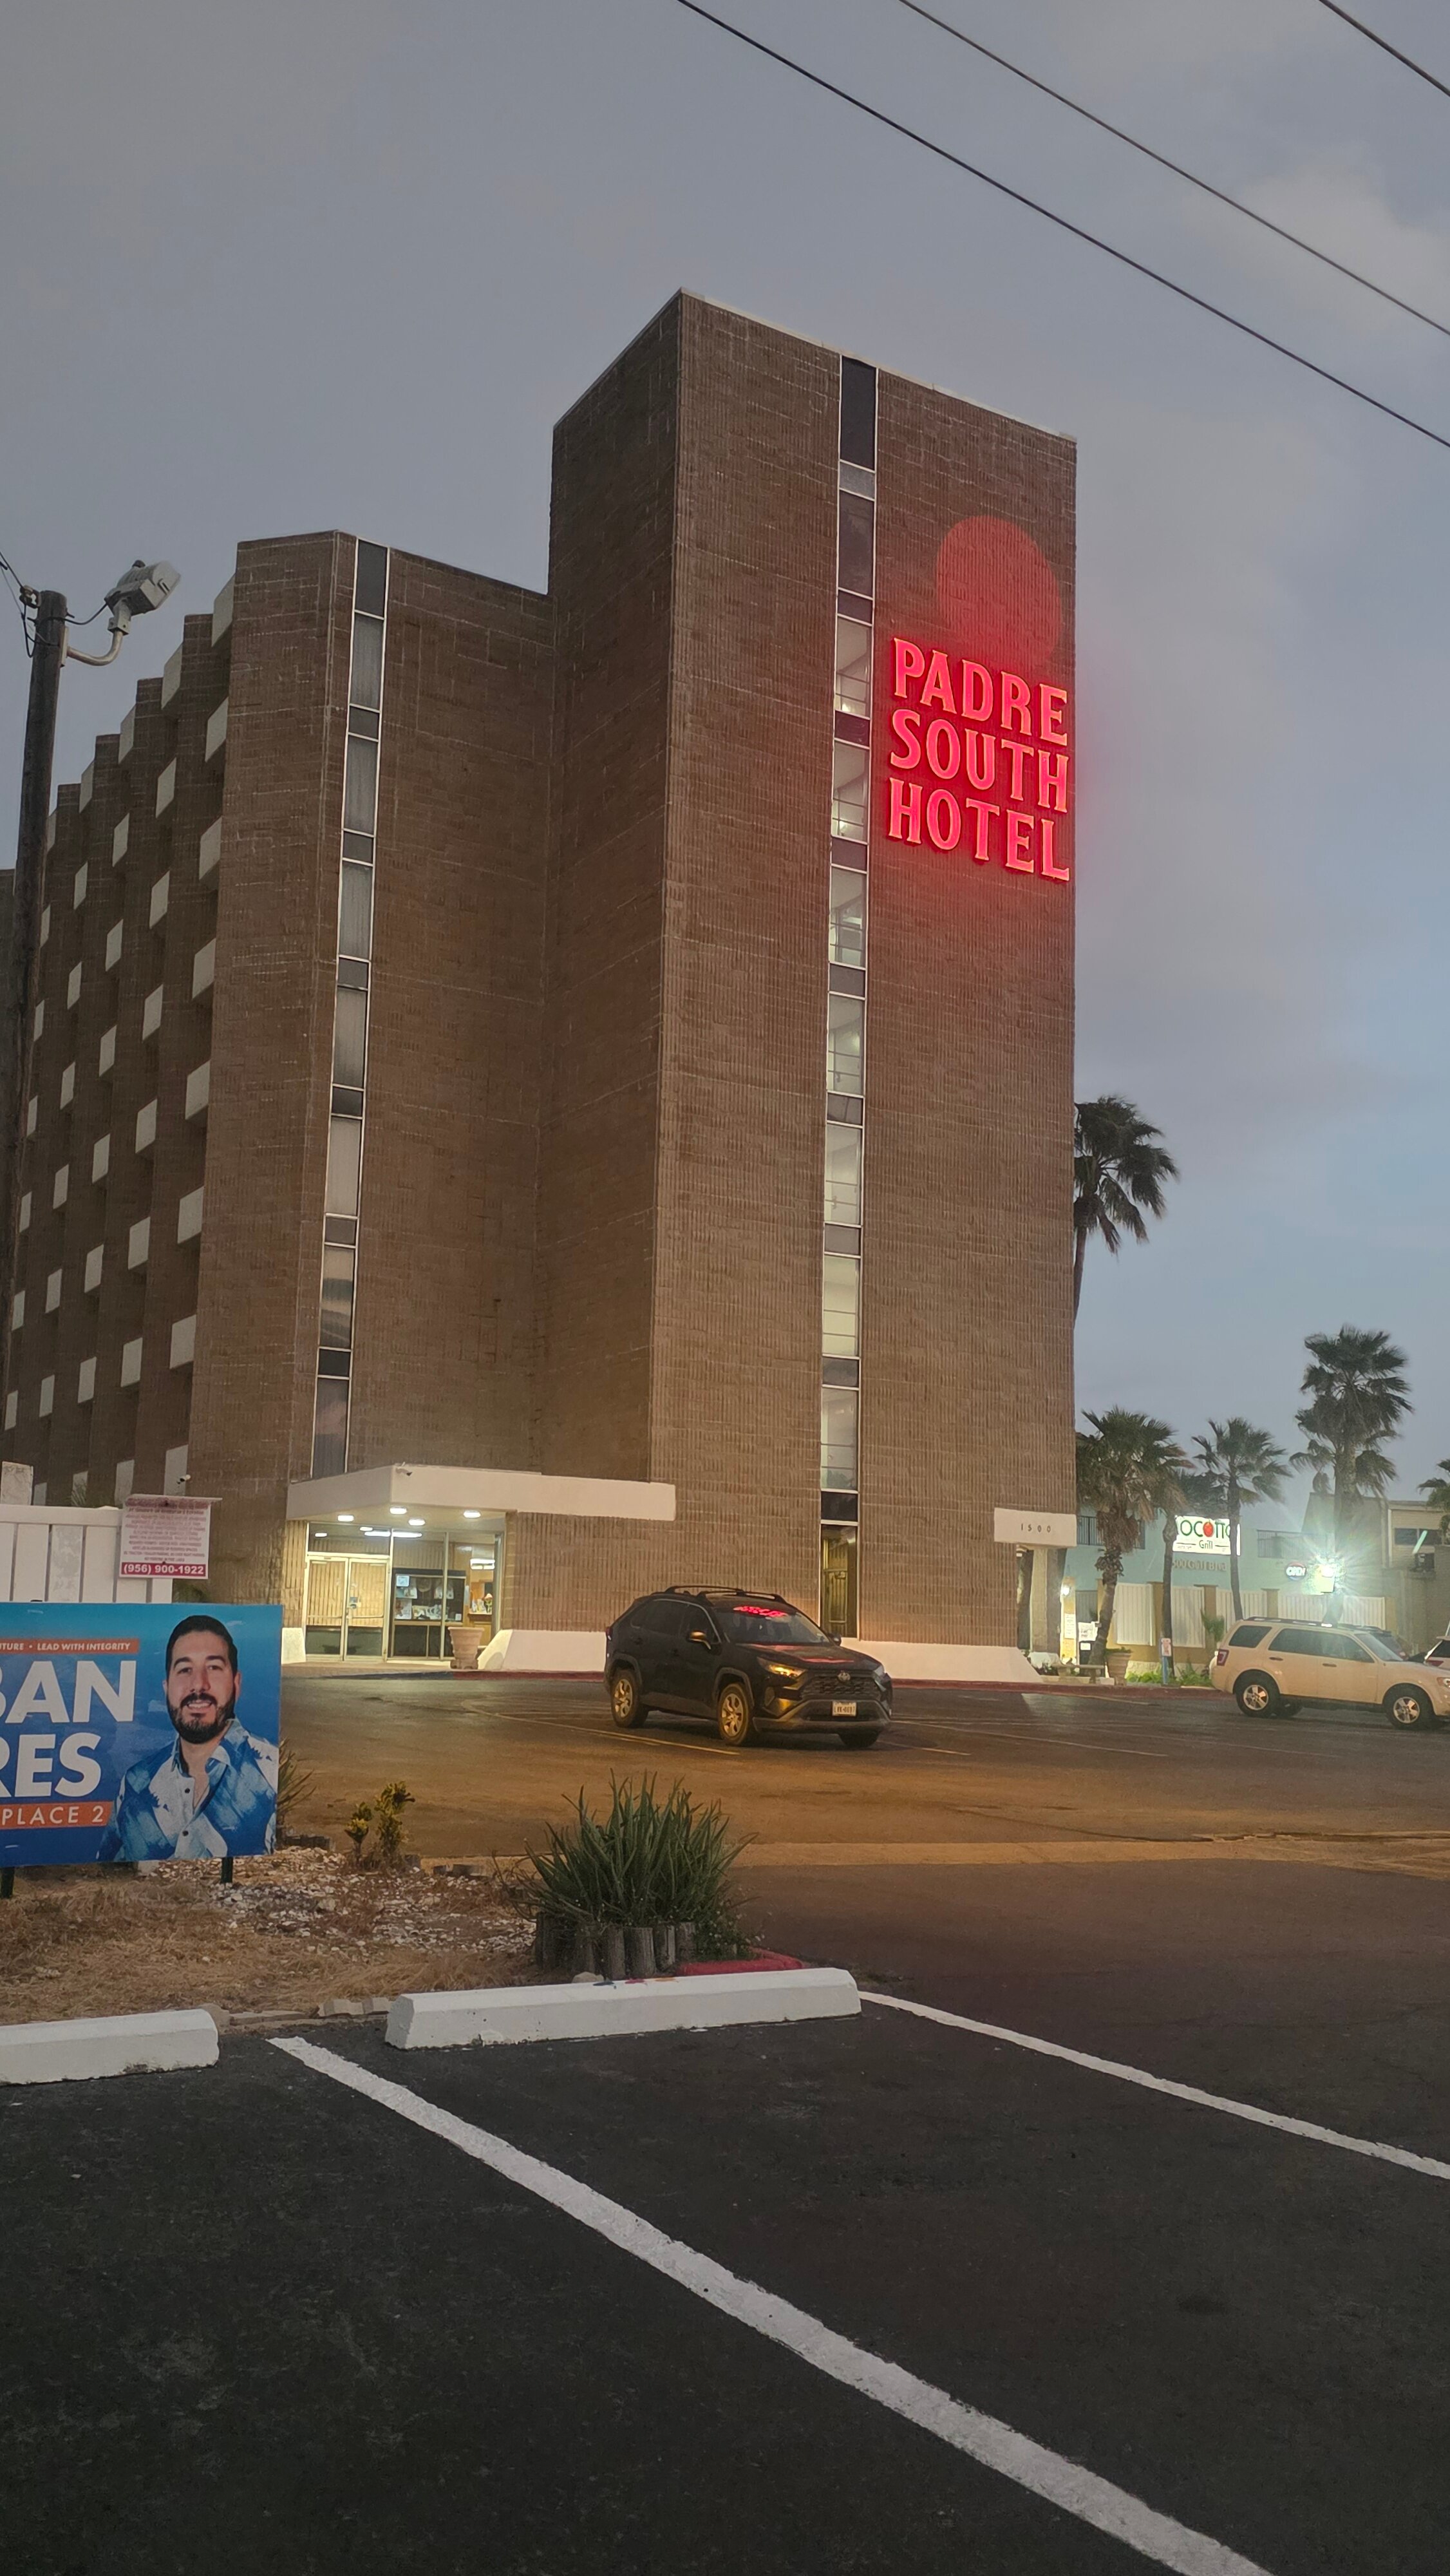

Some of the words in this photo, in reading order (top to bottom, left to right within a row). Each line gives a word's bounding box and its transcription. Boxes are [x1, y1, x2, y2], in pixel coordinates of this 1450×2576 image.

[893, 637, 1068, 746] PADRE
[890, 708, 1068, 813] SOUTH
[888, 777, 1069, 881] HOTEL
[1021, 1523, 1051, 1533] 1500
[124, 1564, 152, 1575] (956)
[155, 1565, 204, 1575] 900-1922
[0, 1660, 137, 1723] AN
[2, 1806, 80, 1826] PLACE
[92, 1805, 104, 1823] 2
